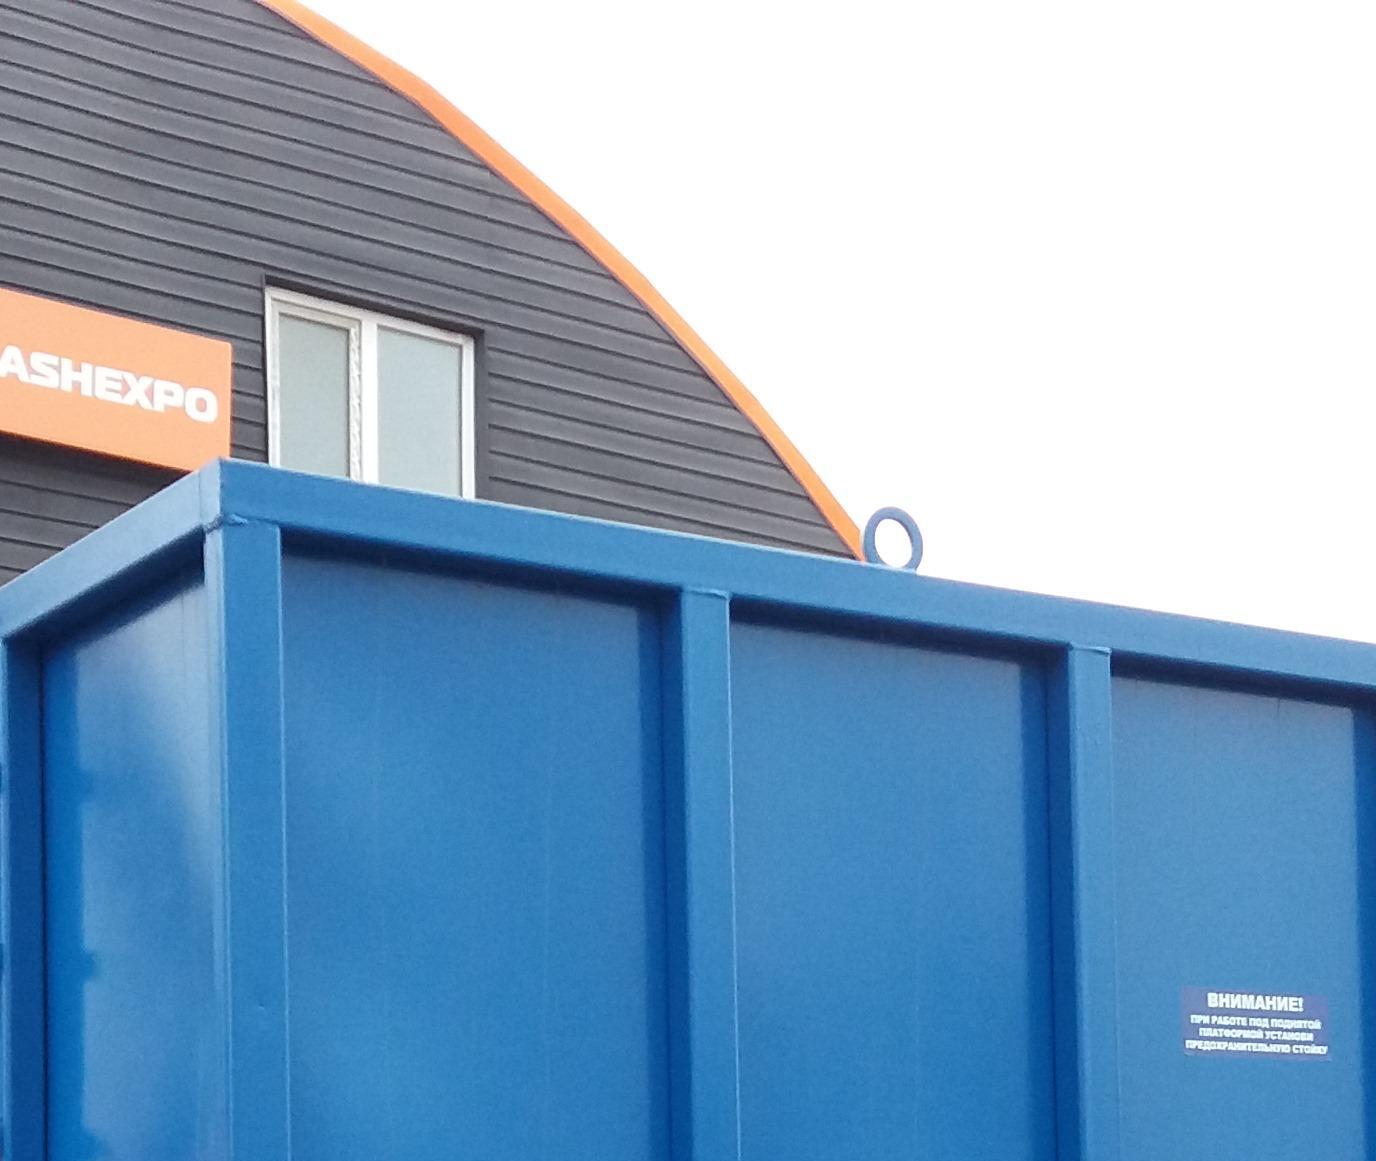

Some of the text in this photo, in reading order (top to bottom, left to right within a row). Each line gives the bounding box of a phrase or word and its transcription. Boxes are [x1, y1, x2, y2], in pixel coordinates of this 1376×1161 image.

[1207, 992, 1304, 1012] ВНИМАНИЕ!
[1190, 1014, 1321, 1029] ПРИ РАБОТЕ ПОД ПОДНЯТОЙ
[1199, 1027, 1263, 1038] ПЛАТФОРМОЙ
[1185, 1039, 1328, 1054] ПРЕДОХРАНИТЕЛЬНУЮ СТОЙКУ
